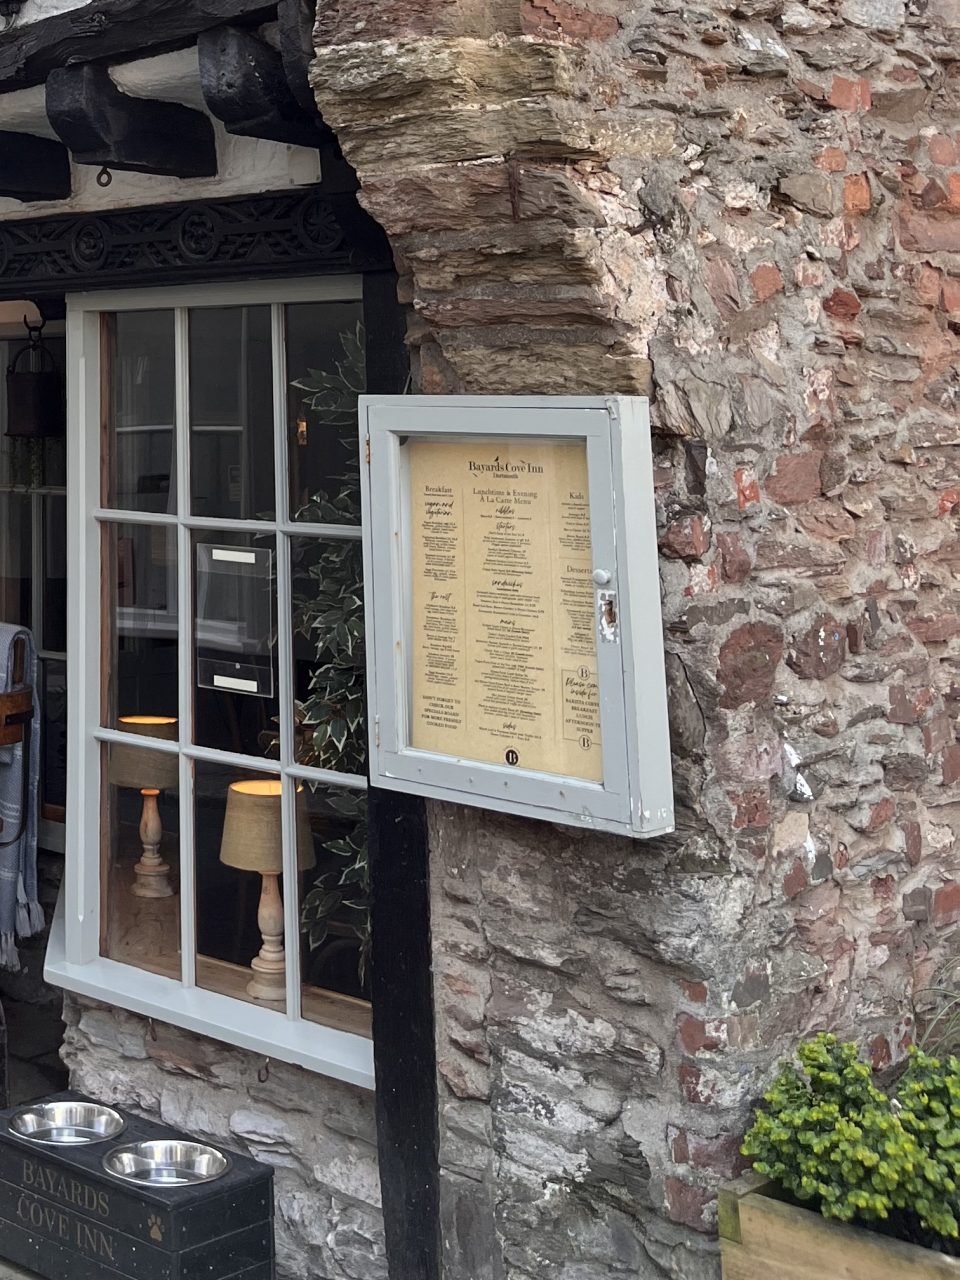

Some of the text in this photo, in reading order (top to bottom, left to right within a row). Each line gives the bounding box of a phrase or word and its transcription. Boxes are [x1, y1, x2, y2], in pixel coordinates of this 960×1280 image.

[468, 461, 544, 474] Bayards Cove Inn
[425, 485, 452, 493] Breakfast
[23, 1159, 110, 1217] BAYARDS
[17, 1196, 113, 1260] COVE INN
